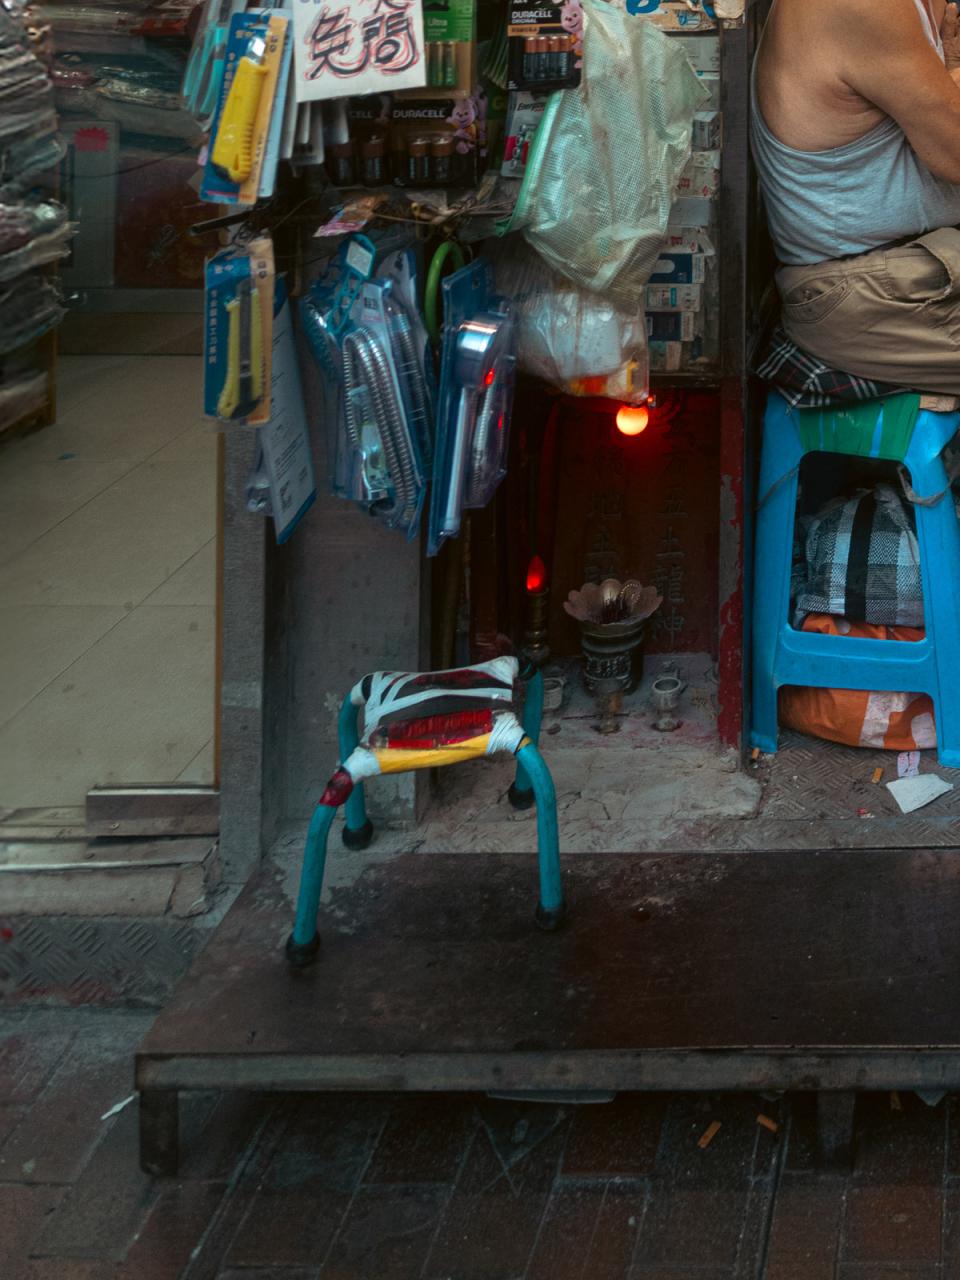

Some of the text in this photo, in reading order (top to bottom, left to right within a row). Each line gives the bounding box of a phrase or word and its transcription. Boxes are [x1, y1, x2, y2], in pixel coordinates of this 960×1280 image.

[512, 10, 552, 19] DURACELL
[350, 109, 447, 119] CELL DURACELL
